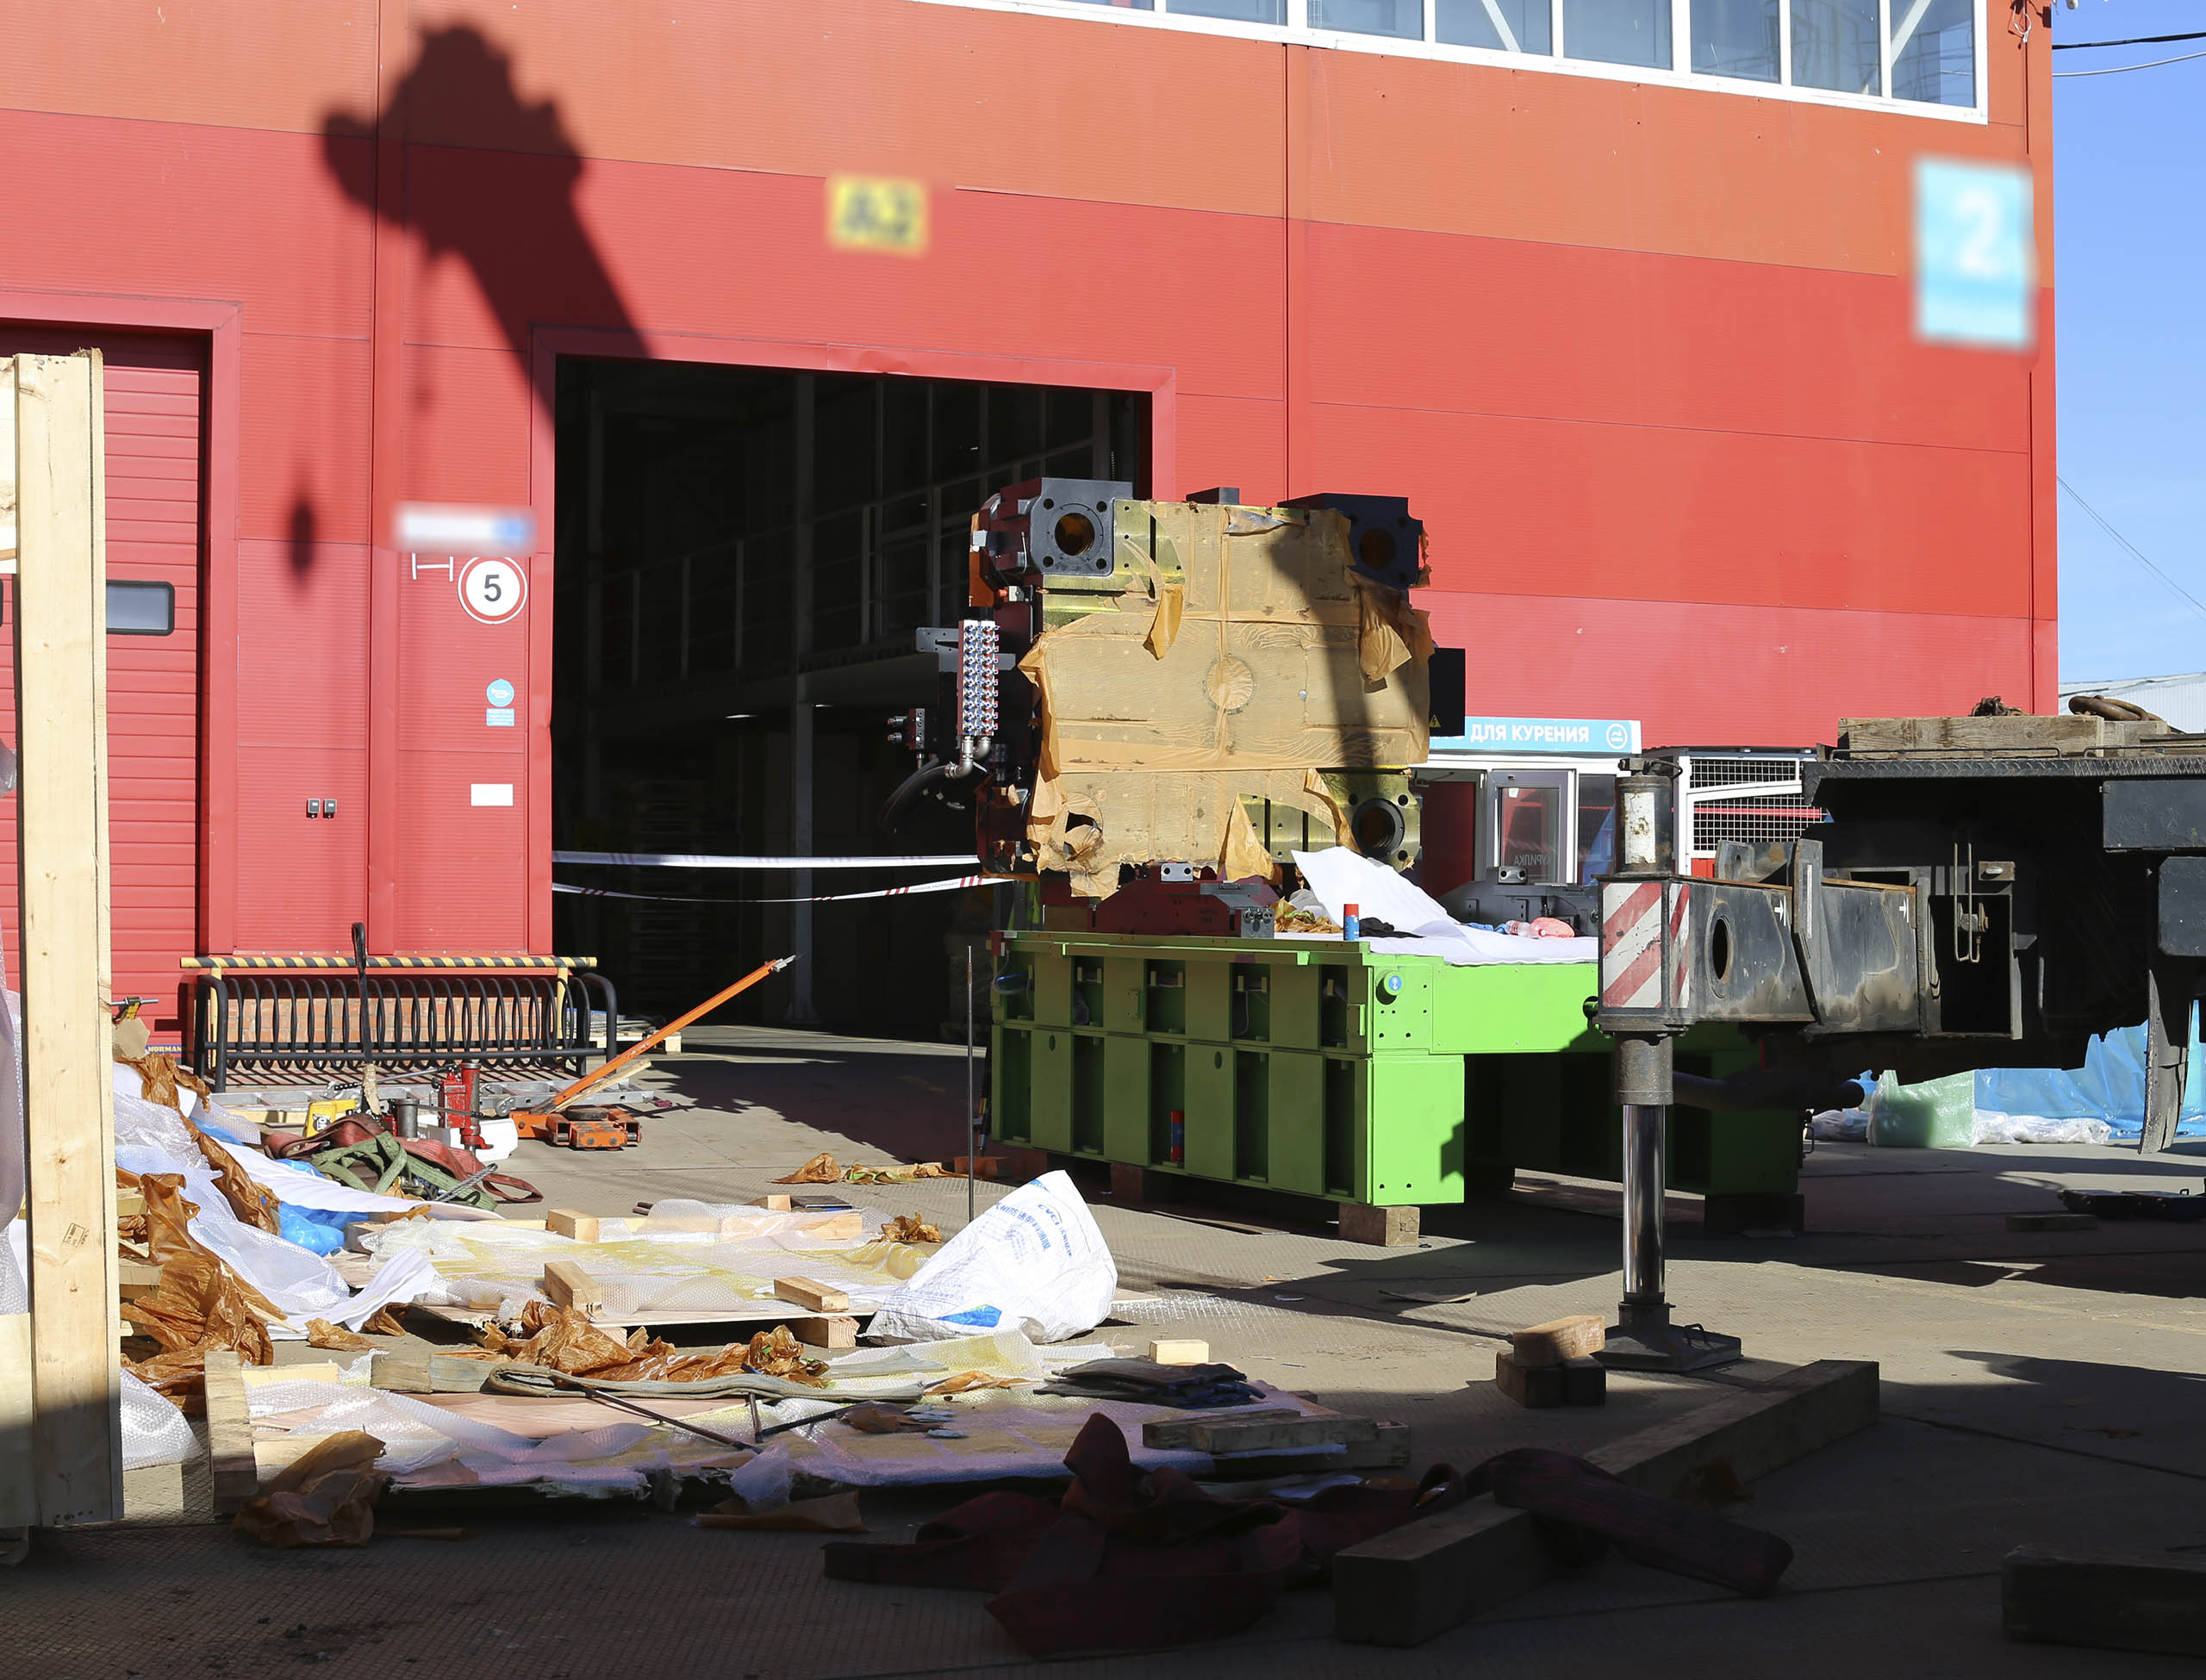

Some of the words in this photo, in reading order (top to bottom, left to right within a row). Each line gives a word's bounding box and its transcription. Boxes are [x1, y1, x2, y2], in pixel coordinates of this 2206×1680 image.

[1955, 187, 2002, 277] 2
[484, 575, 502, 601] 5
[1470, 724, 1506, 743] ДЛЯ
[1513, 725, 1589, 744] КУРЕНИЯ
